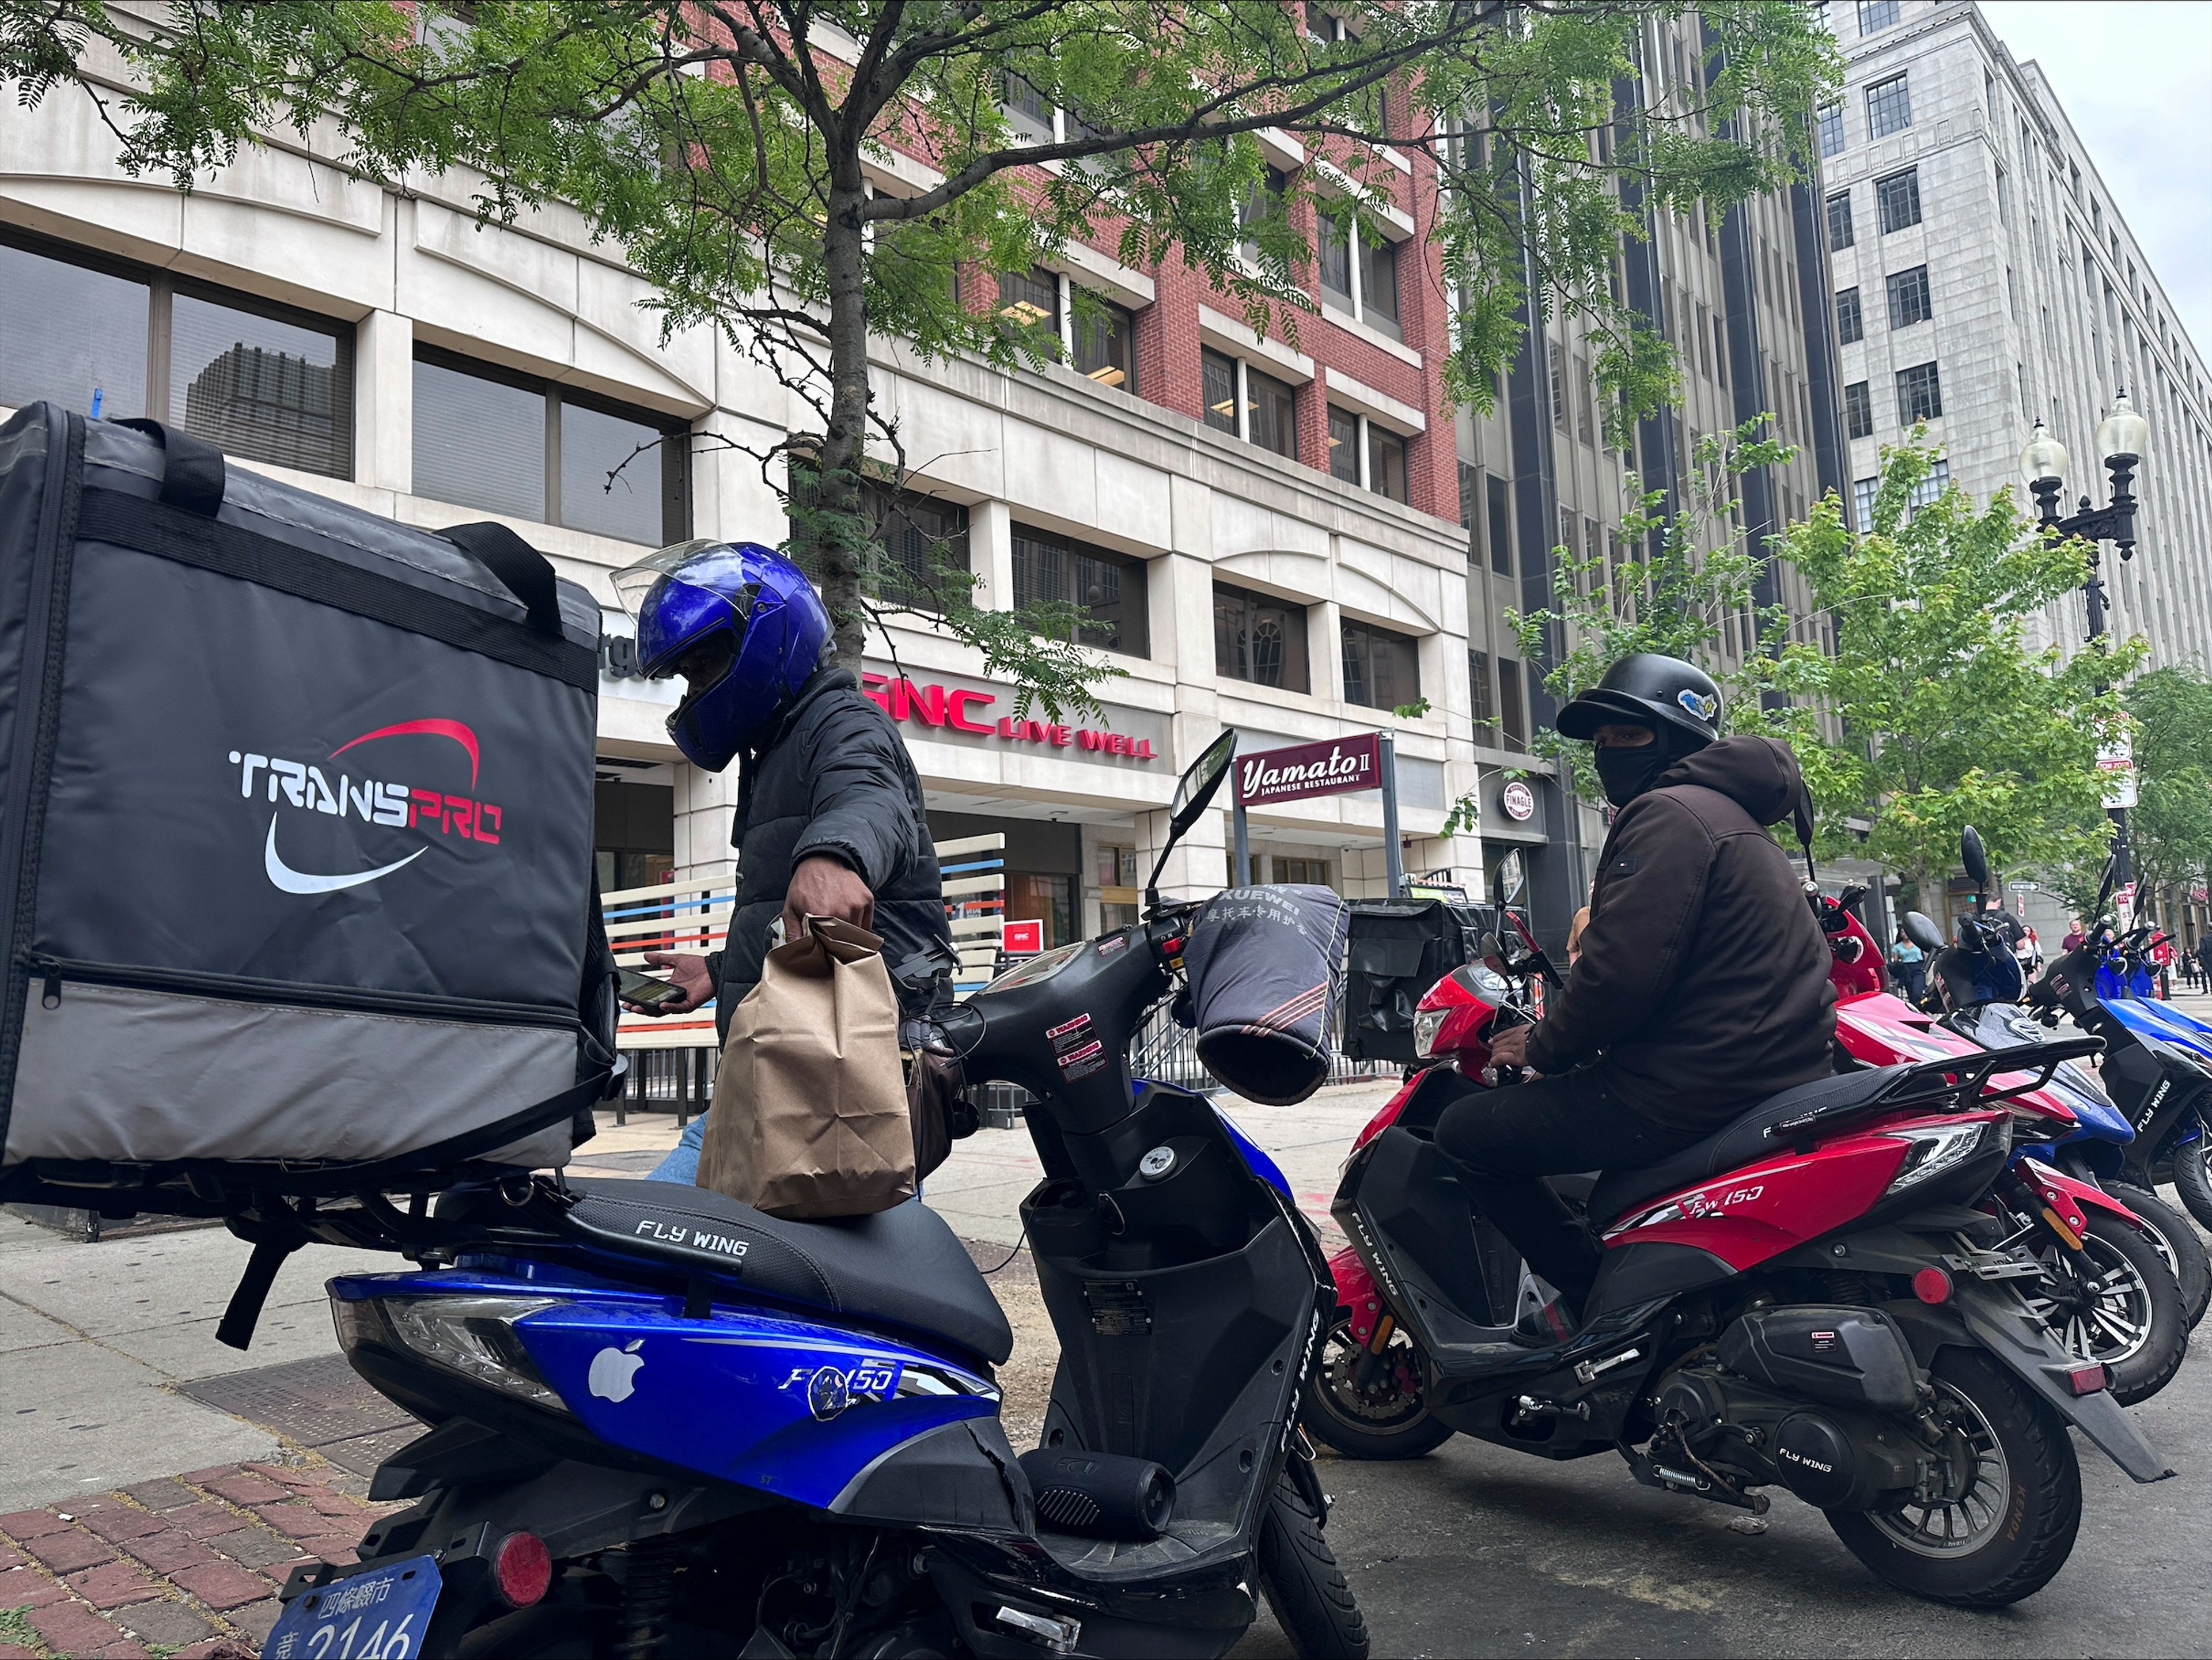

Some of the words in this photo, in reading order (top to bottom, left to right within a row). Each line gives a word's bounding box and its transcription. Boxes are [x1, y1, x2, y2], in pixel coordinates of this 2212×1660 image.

[998, 716, 1072, 747] LIVE
[1076, 729, 1158, 759] WELL
[1243, 746, 1357, 798] Yamato
[1261, 782, 1301, 796] JAPANESE
[1304, 774, 1359, 789] RESTAURANT
[229, 751, 502, 844] TRANSPRO
[1506, 795, 1532, 808] FINAGLE
[1218, 889, 1300, 916] XUEWEI
[2137, 1108, 2154, 1132] FLY
[2151, 1080, 2172, 1108] WING
[1724, 1185, 1764, 1206] 150
[635, 1220, 688, 1242] FLY
[692, 1231, 750, 1257] WING
[1351, 1212, 1373, 1248] FLY
[1372, 1252, 1399, 1296] WING
[1779, 1447, 1800, 1462] FLY
[1802, 1457, 1832, 1473] WING
[2006, 1484, 2026, 1542] KENDA
[307, 1614, 414, 1659] 2146
